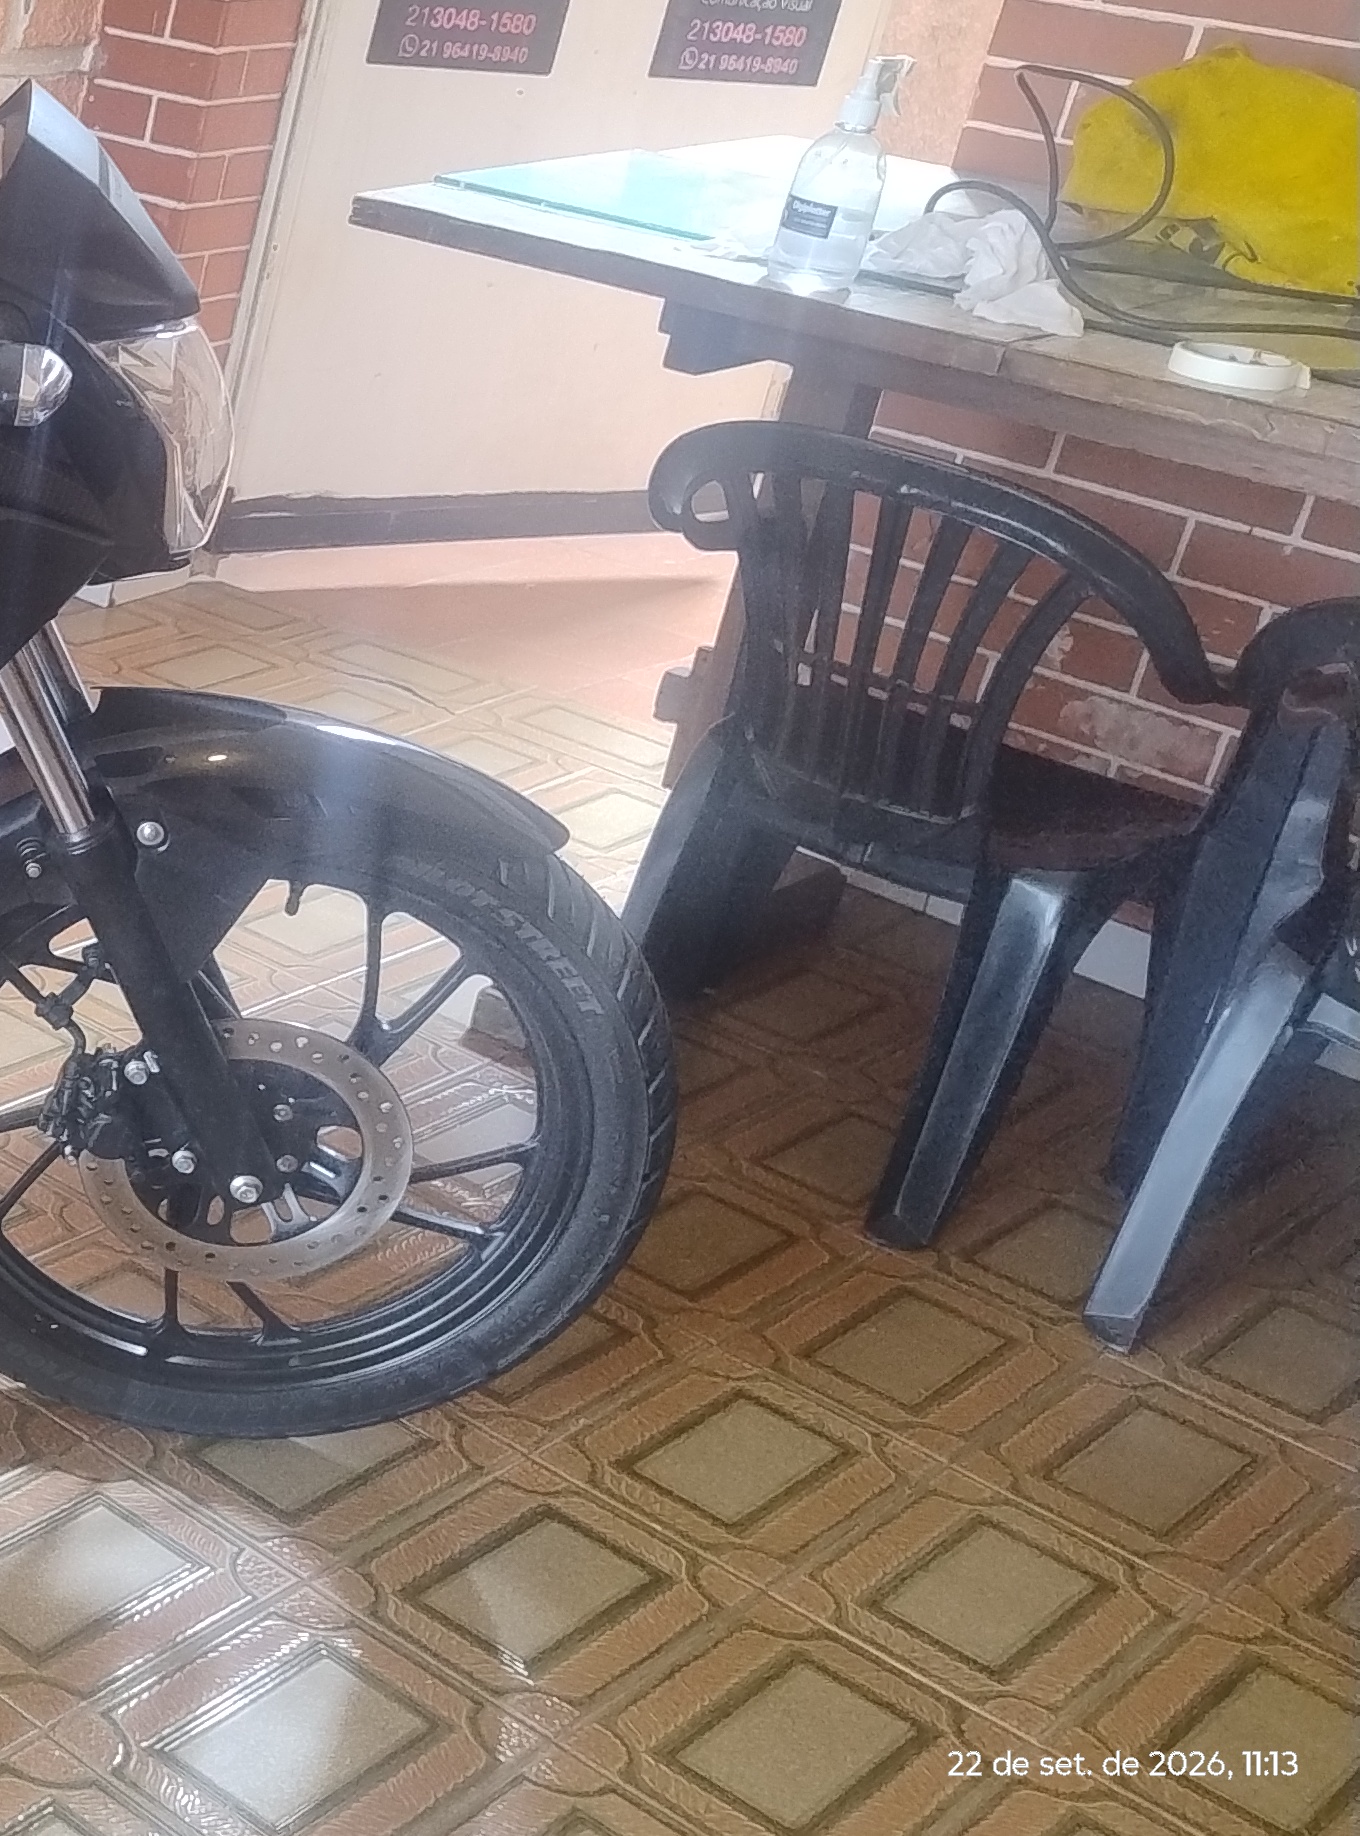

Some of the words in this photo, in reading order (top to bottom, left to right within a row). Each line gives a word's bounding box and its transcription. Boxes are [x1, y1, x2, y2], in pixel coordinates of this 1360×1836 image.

[421, 40, 439, 58] 21
[697, 52, 717, 71] 21
[490, 906, 606, 1016] STREET
